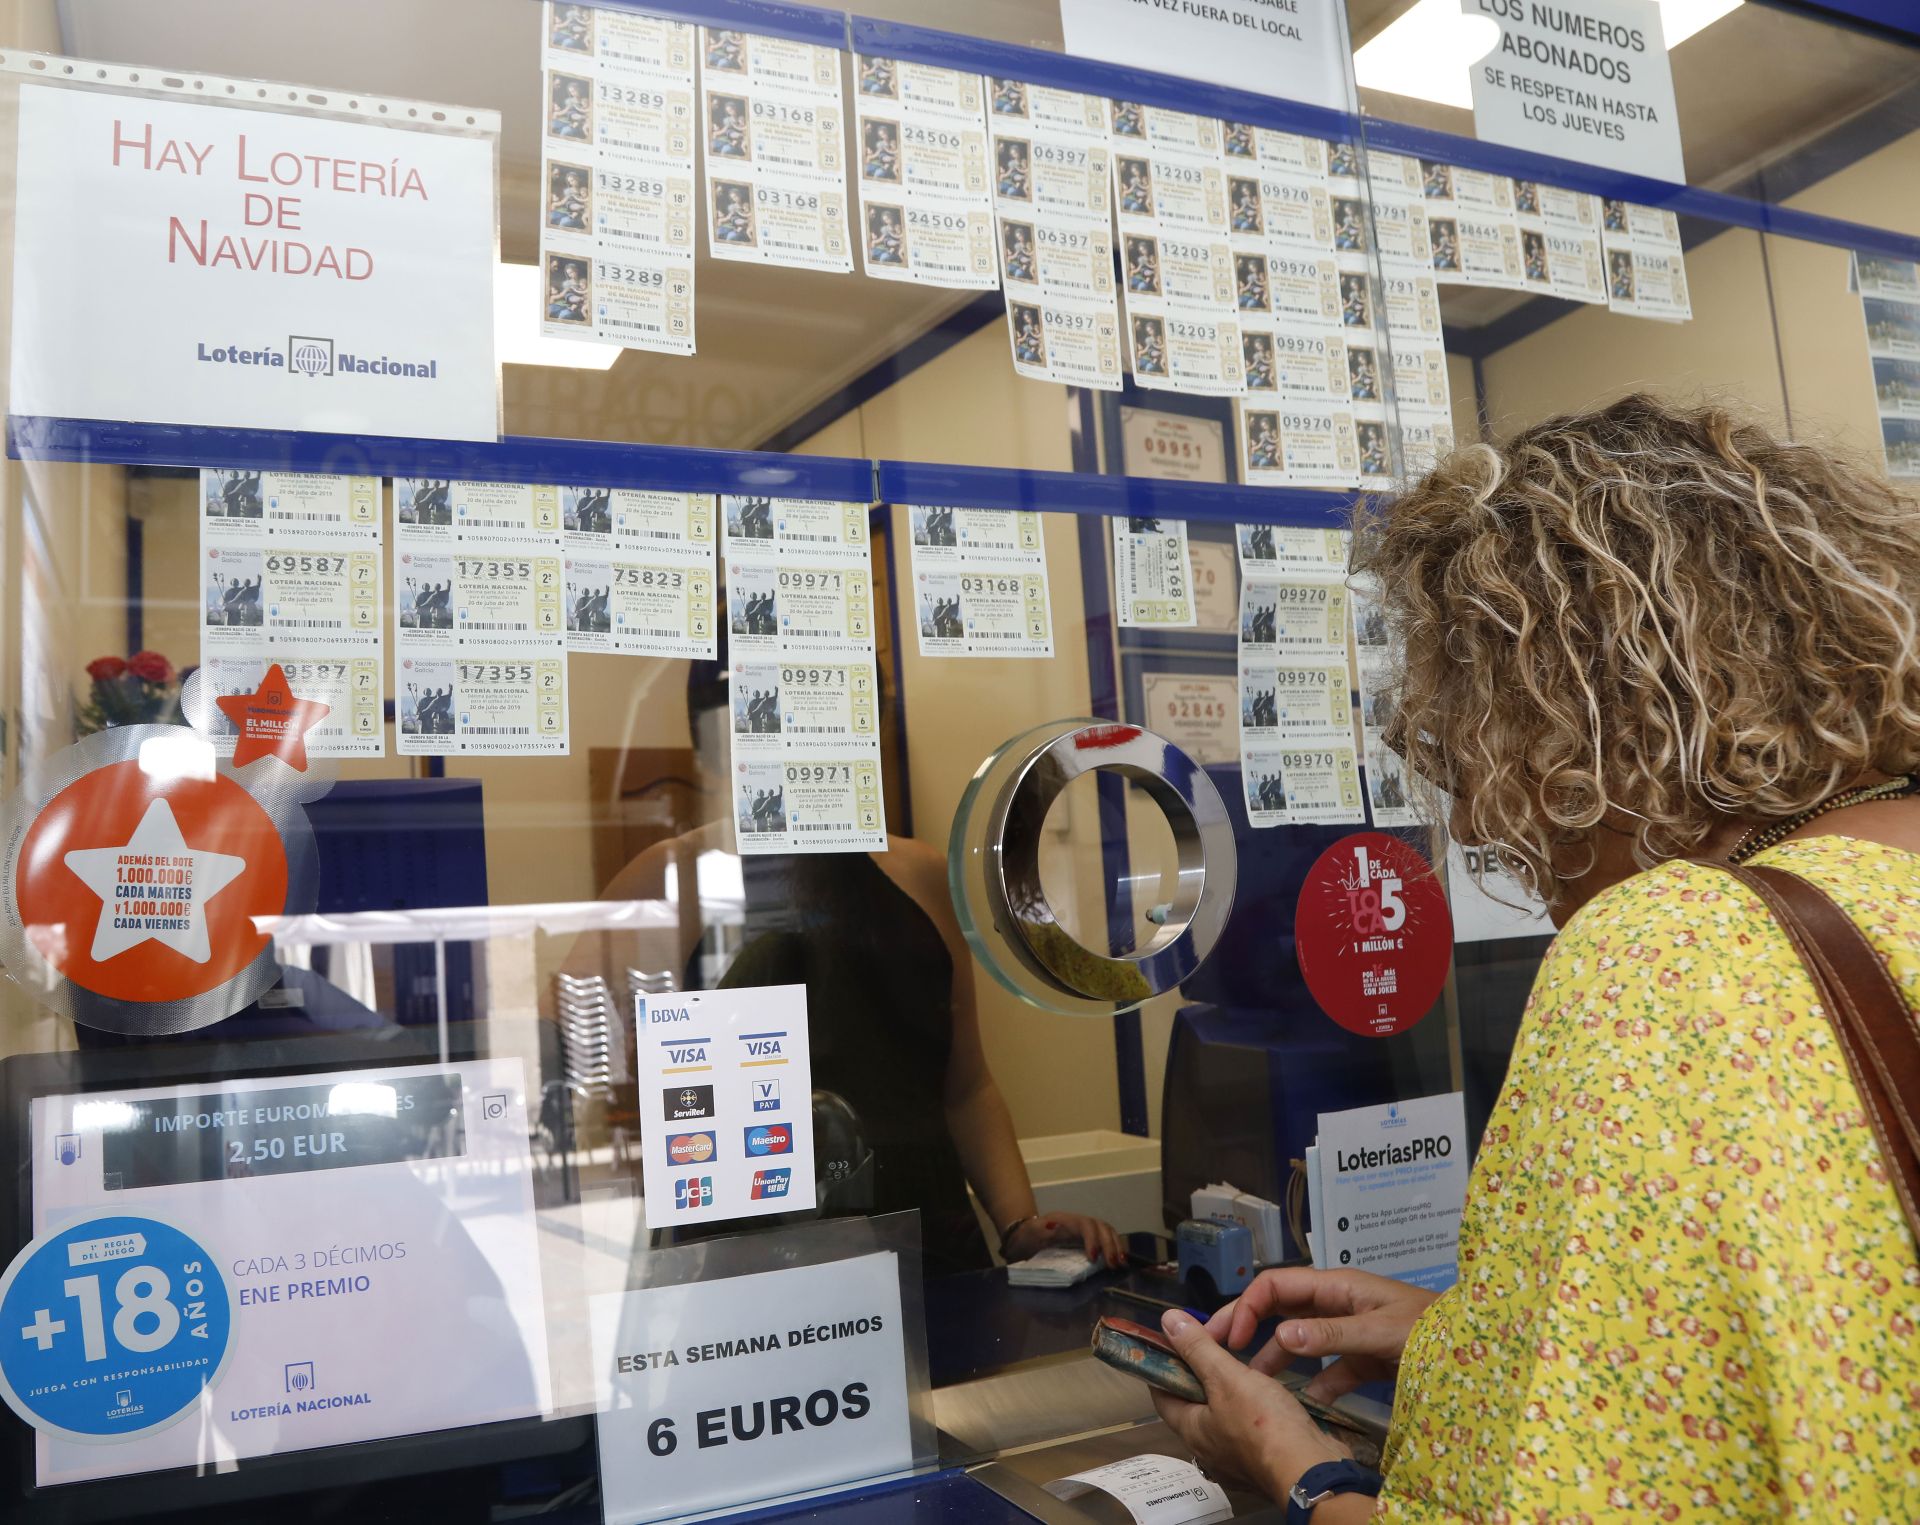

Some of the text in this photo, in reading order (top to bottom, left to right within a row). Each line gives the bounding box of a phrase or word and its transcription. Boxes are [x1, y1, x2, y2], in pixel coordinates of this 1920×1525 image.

[1154, 0, 1302, 41] VEZ FUERA DEL LOCAL
[1479, 0, 1645, 52] LOS NUMEROS
[1502, 32, 1631, 84] ABONADOS
[600, 85, 663, 107] 13289
[1484, 67, 1658, 123] SE RESPETAN HASTA
[753, 103, 813, 123] 03168
[1523, 102, 1625, 141] LOS JUEVES
[905, 127, 960, 148] 24506
[113, 120, 428, 200] HAY LOTERÍA
[1034, 145, 1086, 165] 06397
[1155, 164, 1202, 183] 12203
[600, 174, 663, 196] 13289
[1263, 184, 1309, 202] 09970
[757, 190, 818, 209] 03168
[244, 193, 301, 230] DE
[909, 211, 966, 229] 24506
[1374, 204, 1407, 220] 0791
[1038, 229, 1088, 247] 06397
[168, 216, 373, 281] NAVIDAD
[1161, 242, 1209, 260] 12203
[598, 264, 663, 286] 13289
[1270, 259, 1316, 276] 09970
[1045, 312, 1094, 330] 06397
[1168, 321, 1216, 340] 12203
[1277, 336, 1324, 352] 09970
[197, 343, 436, 378] Lotería Nacional
[1283, 415, 1331, 431] 09970
[266, 555, 345, 573] 69587
[458, 561, 530, 577] 17355
[1166, 537, 1183, 598] 03168
[614, 568, 682, 587] 75823
[779, 572, 841, 587] 09971
[962, 578, 1019, 592] 03168
[1280, 588, 1326, 601] 09970
[285, 664, 346, 680] 9587
[460, 665, 531, 681] 17355
[782, 669, 845, 683] 09971
[1278, 672, 1326, 684] 09970
[1283, 753, 1333, 766] 09970
[786, 766, 850, 781] 09971
[118, 854, 193, 867] ADEMÁS DEL BOTE
[1354, 846, 1370, 888] 1
[1370, 860, 1381, 869] DE
[1370, 868, 1396, 879] CADA
[116, 886, 191, 899] CADA MARTES
[1382, 878, 1406, 931] 5
[114, 918, 190, 930] CADA VIERNES
[1354, 942, 1359, 952] 1
[1362, 937, 1394, 952] MILLÓN
[1364, 986, 1397, 996] CON JOKER
[652, 1008, 690, 1023] BBVA
[667, 1048, 706, 1063] VISA
[745, 1041, 781, 1055] VISA
[758, 1084, 772, 1097] V
[155, 1095, 415, 1133] IMPORTE EUROMES
[674, 1108, 705, 1118] ServiRed
[760, 1101, 774, 1109] PAY
[229, 1133, 347, 1164] 2,50 EUR
[671, 1143, 713, 1154] MasterCard
[752, 1135, 785, 1146] Maestro
[1338, 1135, 1452, 1172] LoteríasPRO
[754, 1175, 789, 1187] UnionPay
[676, 1186, 712, 1200] JCB
[1355, 1213, 1369, 1221] Abre
[1381, 1209, 1392, 1217] App
[82, 1246, 135, 1260] DEL JUEGO
[104, 1239, 134, 1249] REGLA
[233, 1242, 407, 1277] CADA 3 DÉCIMOS
[287, 1275, 370, 1299] PREMIO
[184, 1262, 209, 1338] AÑOS
[22, 1266, 180, 1362] +18
[618, 1315, 883, 1374] ESTA SEMANA DÉCIMOS
[30, 1358, 209, 1396] JUEGA CON RESPONSABILIDAD
[107, 1404, 144, 1416] LOTERÍAS
[230, 1393, 371, 1422] LOTERÍA NACIONAL
[647, 1382, 870, 1457] 6 EUROS
[1146, 1490, 1191, 1507] EUROMILLONES
